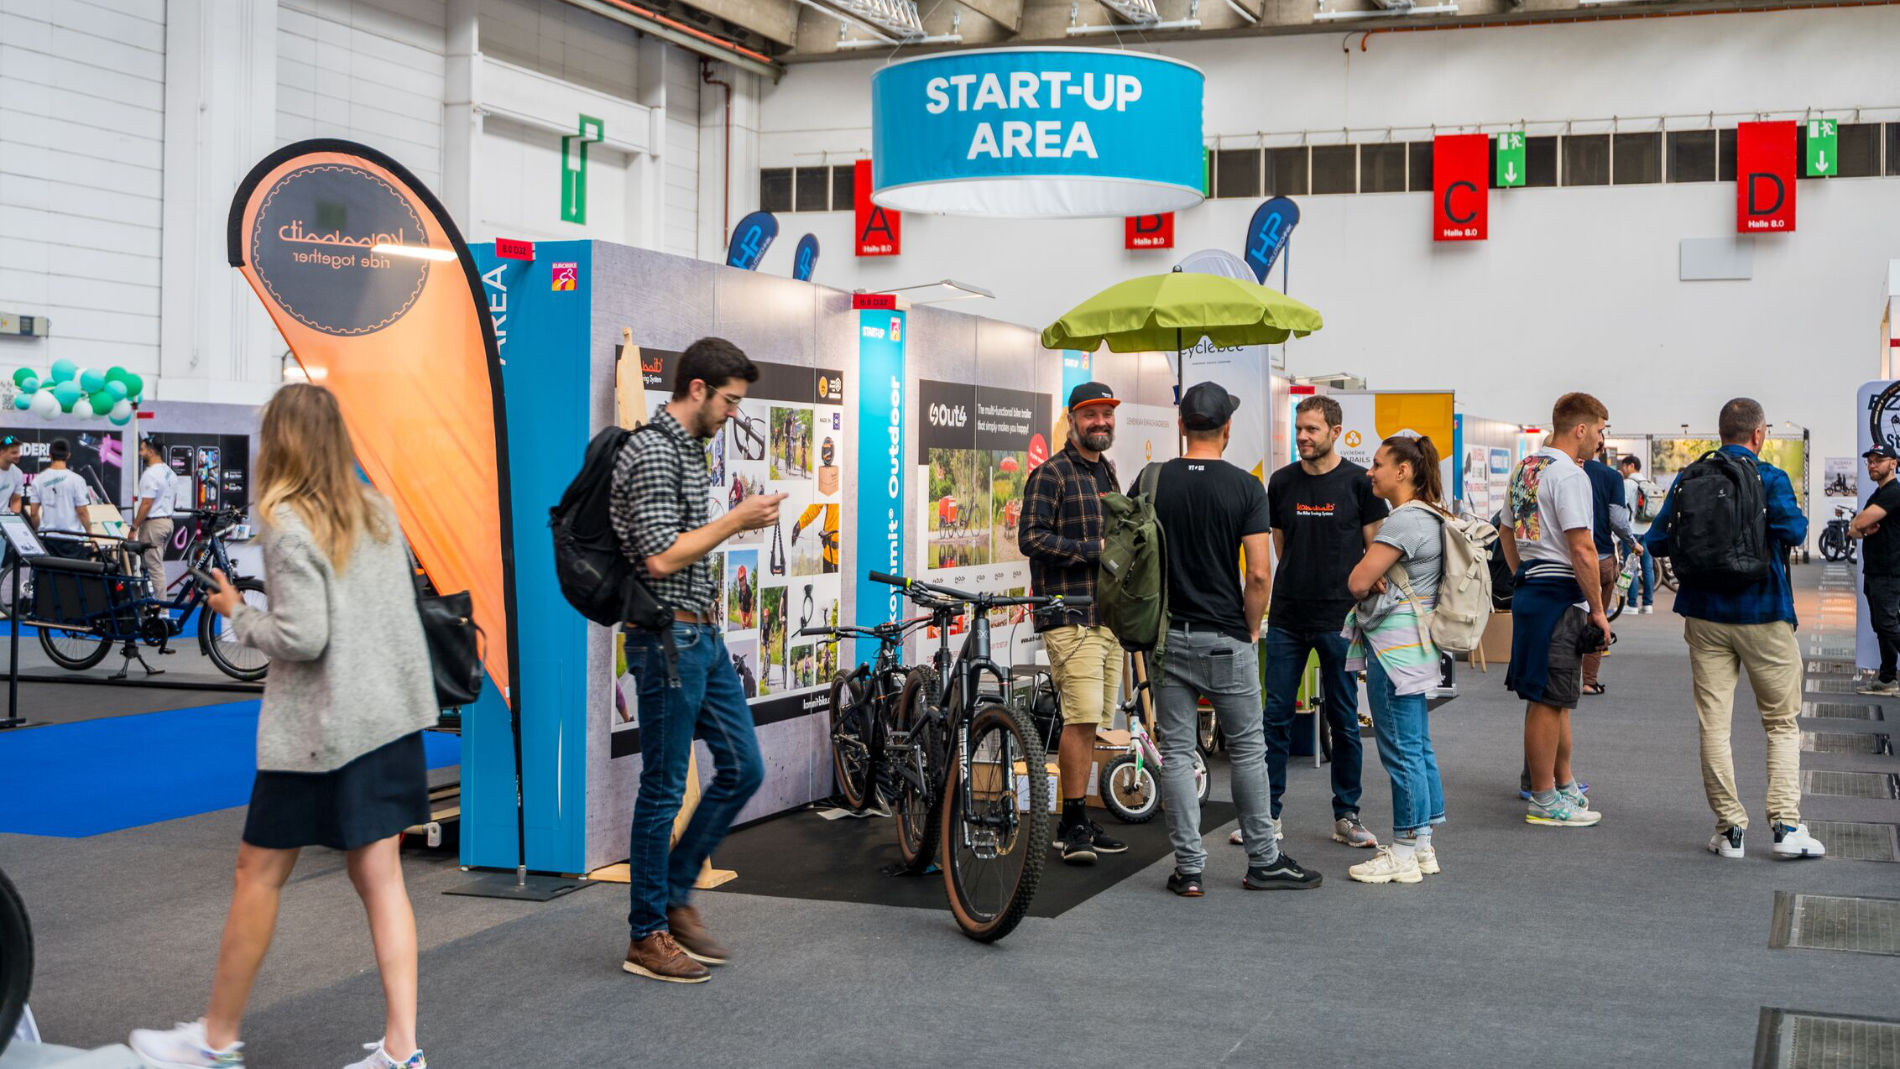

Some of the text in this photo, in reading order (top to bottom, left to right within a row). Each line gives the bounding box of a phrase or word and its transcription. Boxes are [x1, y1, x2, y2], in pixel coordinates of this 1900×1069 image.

[925, 71, 1142, 114] START-UP
[967, 121, 1099, 160] AREA
[1444, 181, 1477, 223] C
[1748, 173, 1785, 215] D
[862, 205, 894, 242] A
[1133, 237, 1152, 245] Halle
[1251, 212, 1282, 265] HP
[1443, 228, 1478, 236] Halle 8.0
[1748, 219, 1785, 228] Halle 8.0
[732, 224, 762, 270] HP
[985, 404, 1013, 417] multi-functional
[986, 421, 997, 433] simply
[998, 421, 1009, 432] makes
[888, 375, 900, 499] Outdoor
